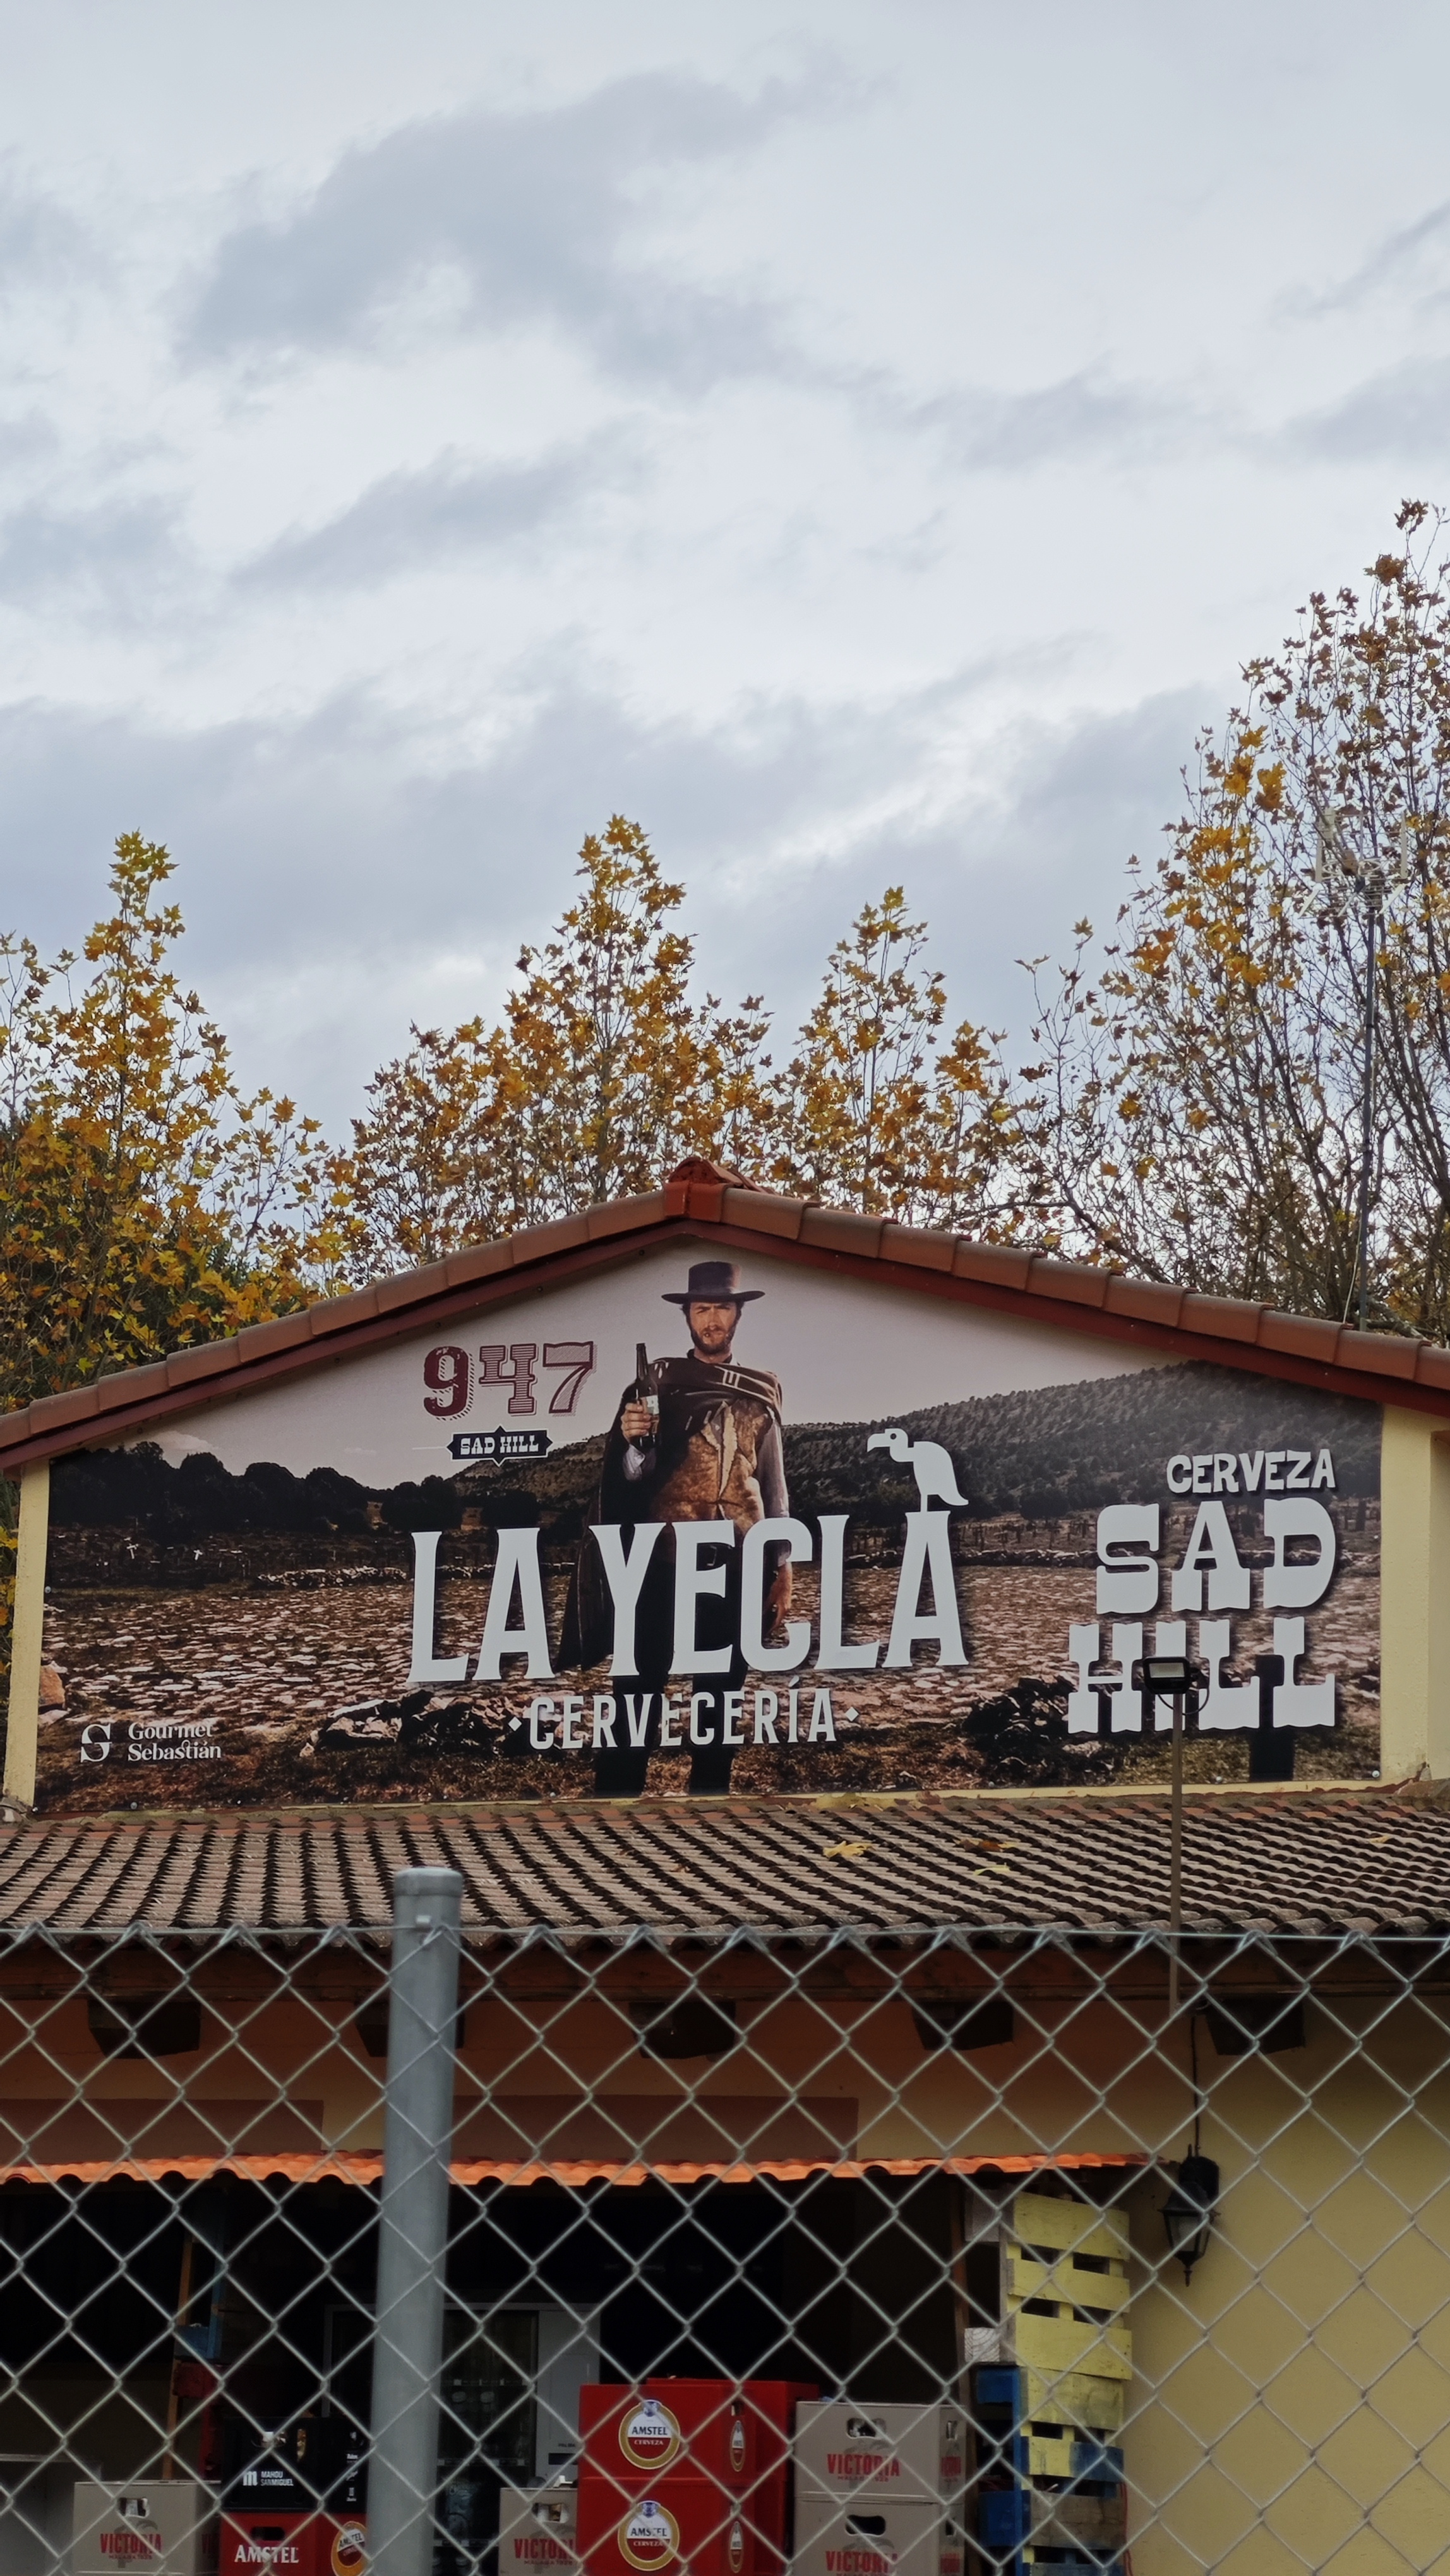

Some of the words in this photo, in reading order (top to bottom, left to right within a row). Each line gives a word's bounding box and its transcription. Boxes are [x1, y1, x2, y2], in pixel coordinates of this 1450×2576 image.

[424, 1341, 596, 1419] 947
[460, 1436, 495, 1455] SAD
[500, 1435, 539, 1453] HILL
[1166, 1448, 1336, 1493] CERVEZA
[1096, 1497, 1336, 1614] SAD
[407, 1527, 555, 1683] LA
[589, 1510, 969, 1677] YECLA
[1068, 1616, 1335, 1734] HILL
[128, 1722, 213, 1740] Gourmet
[529, 1675, 837, 1750] CERVECERÍA
[128, 1739, 221, 1762] Sebastián
[632, 2426, 668, 2435] AMSTEL
[514, 2539, 574, 2559] VICTORI
